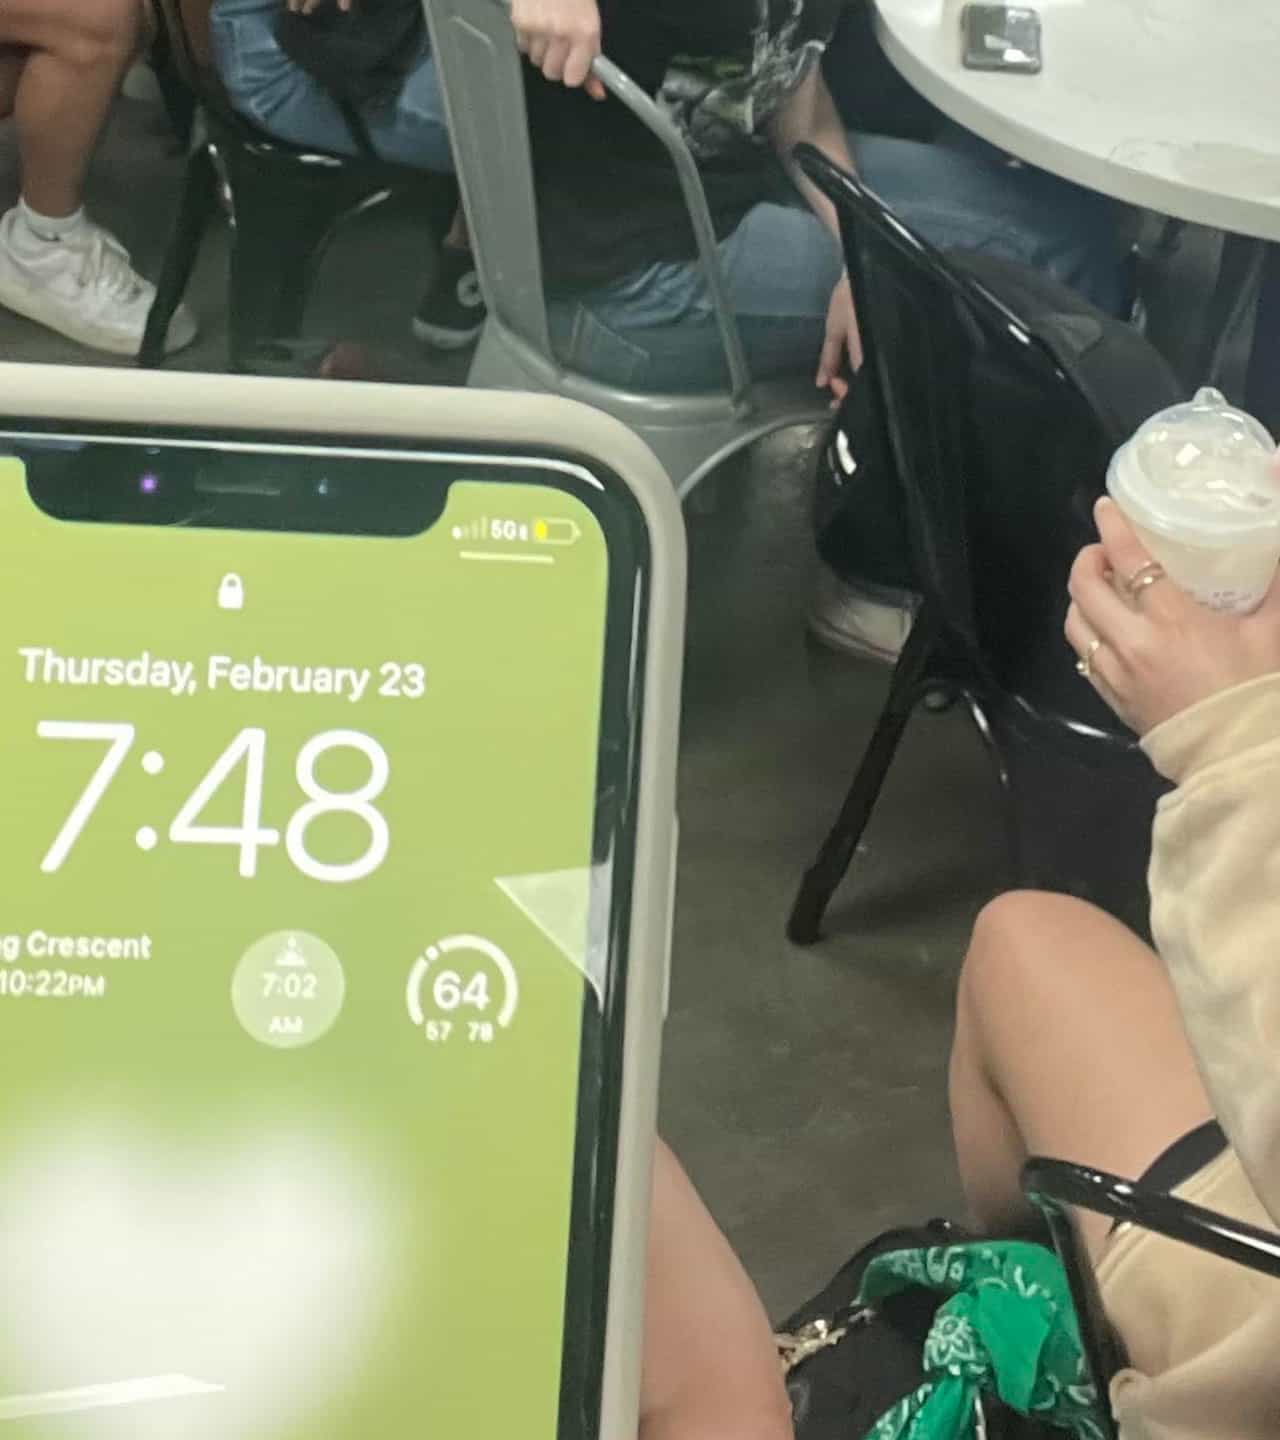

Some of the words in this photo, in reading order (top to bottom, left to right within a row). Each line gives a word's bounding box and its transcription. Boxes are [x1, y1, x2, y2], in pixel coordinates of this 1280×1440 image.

[19, 647, 196, 696] Thursday,
[207, 656, 370, 703] February
[379, 663, 426, 699] 23
[36, 720, 390, 883] 7:48
[26, 929, 151, 960] Crescent
[433, 970, 491, 1011] 64
[269, 1016, 303, 1033] AM
